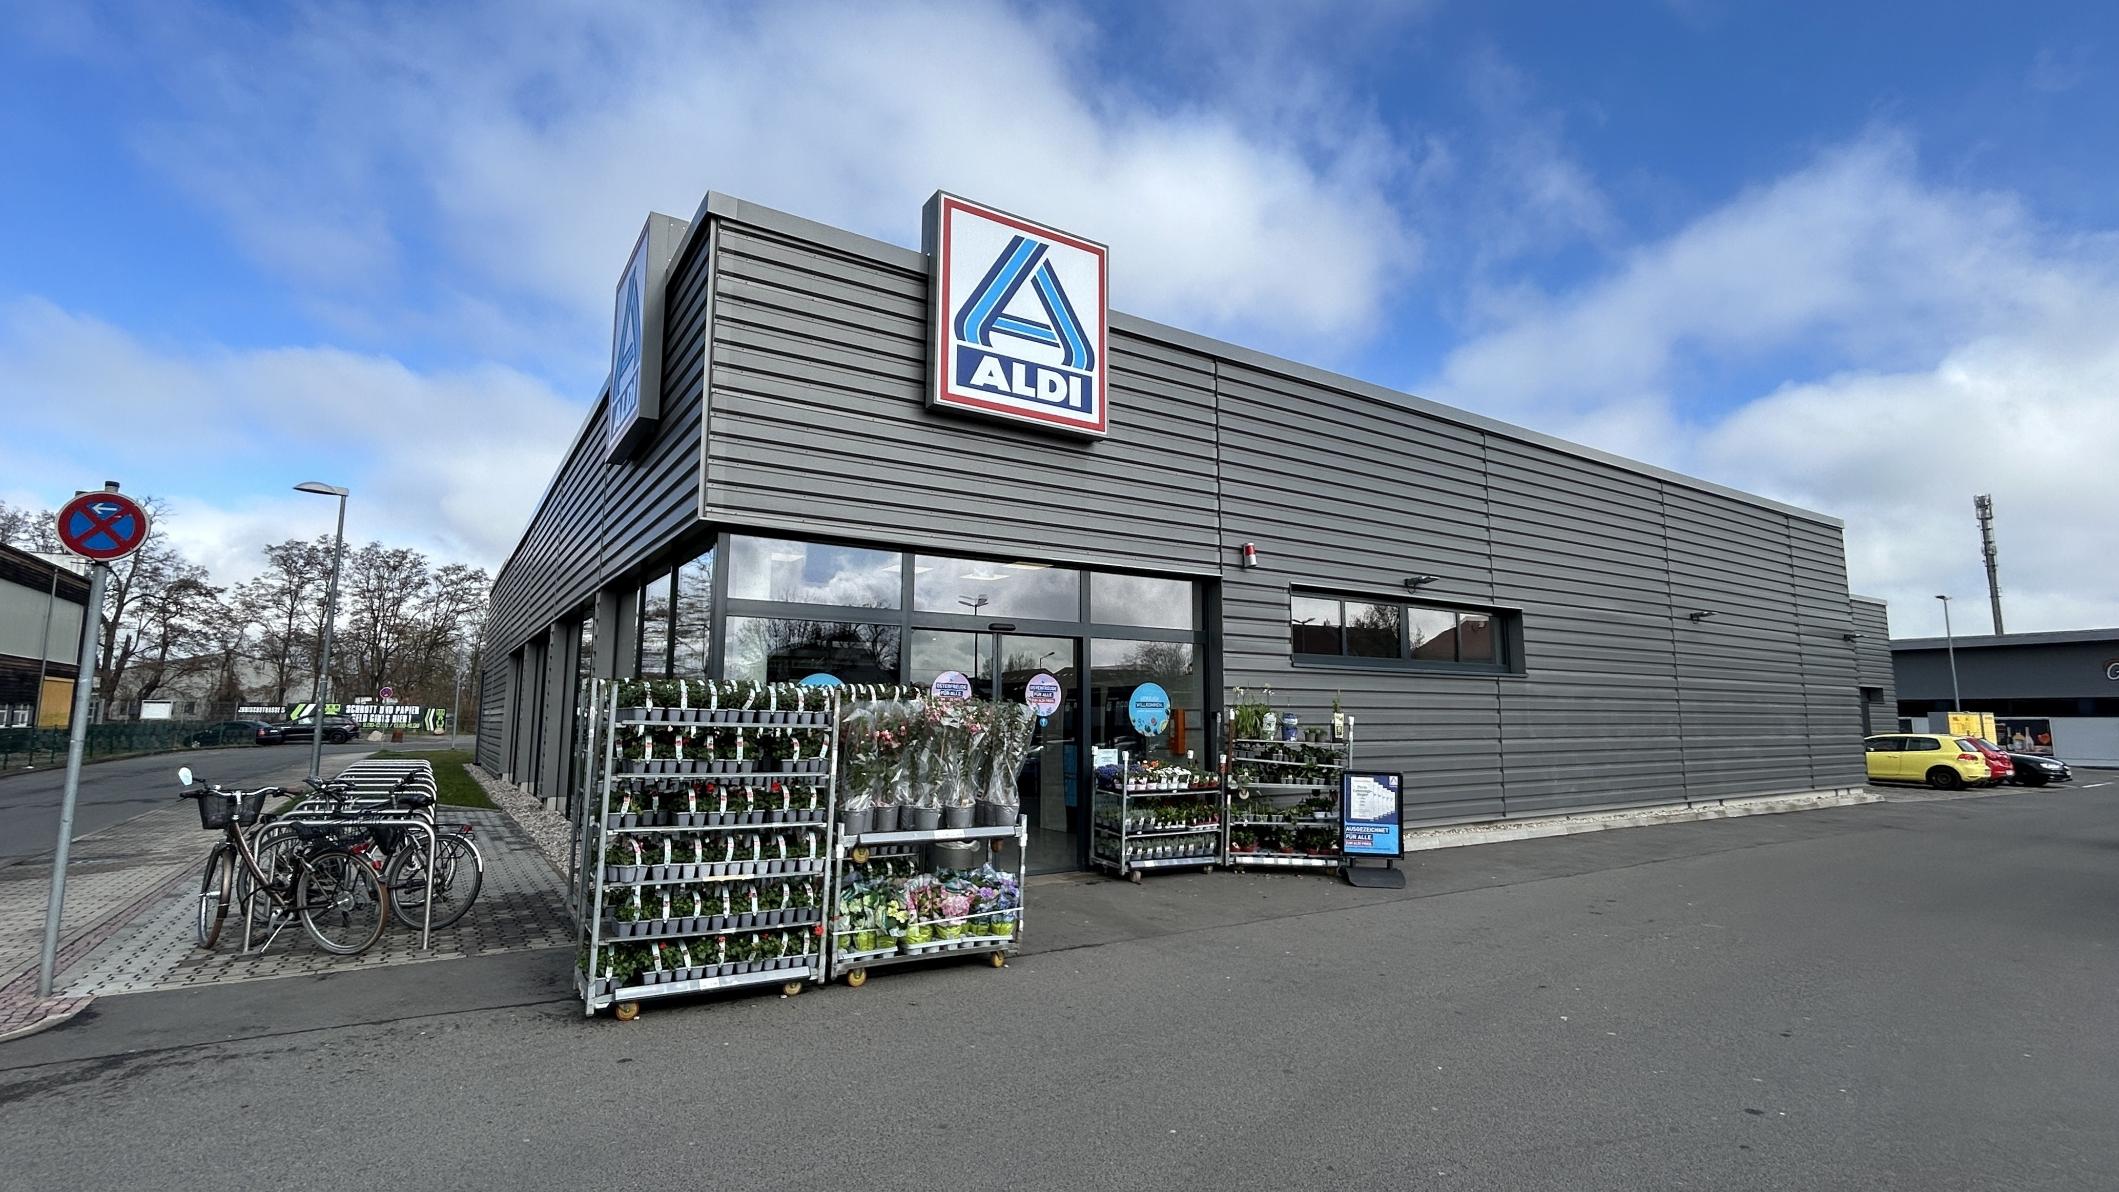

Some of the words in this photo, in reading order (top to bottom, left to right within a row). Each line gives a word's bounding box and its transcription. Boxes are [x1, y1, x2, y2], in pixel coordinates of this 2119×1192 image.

[612, 373, 638, 435] ALDI
[969, 355, 1082, 408] ALDI
[345, 705, 377, 714] SCHROTT
[379, 705, 394, 714] UND
[395, 705, 420, 714] PAPIER
